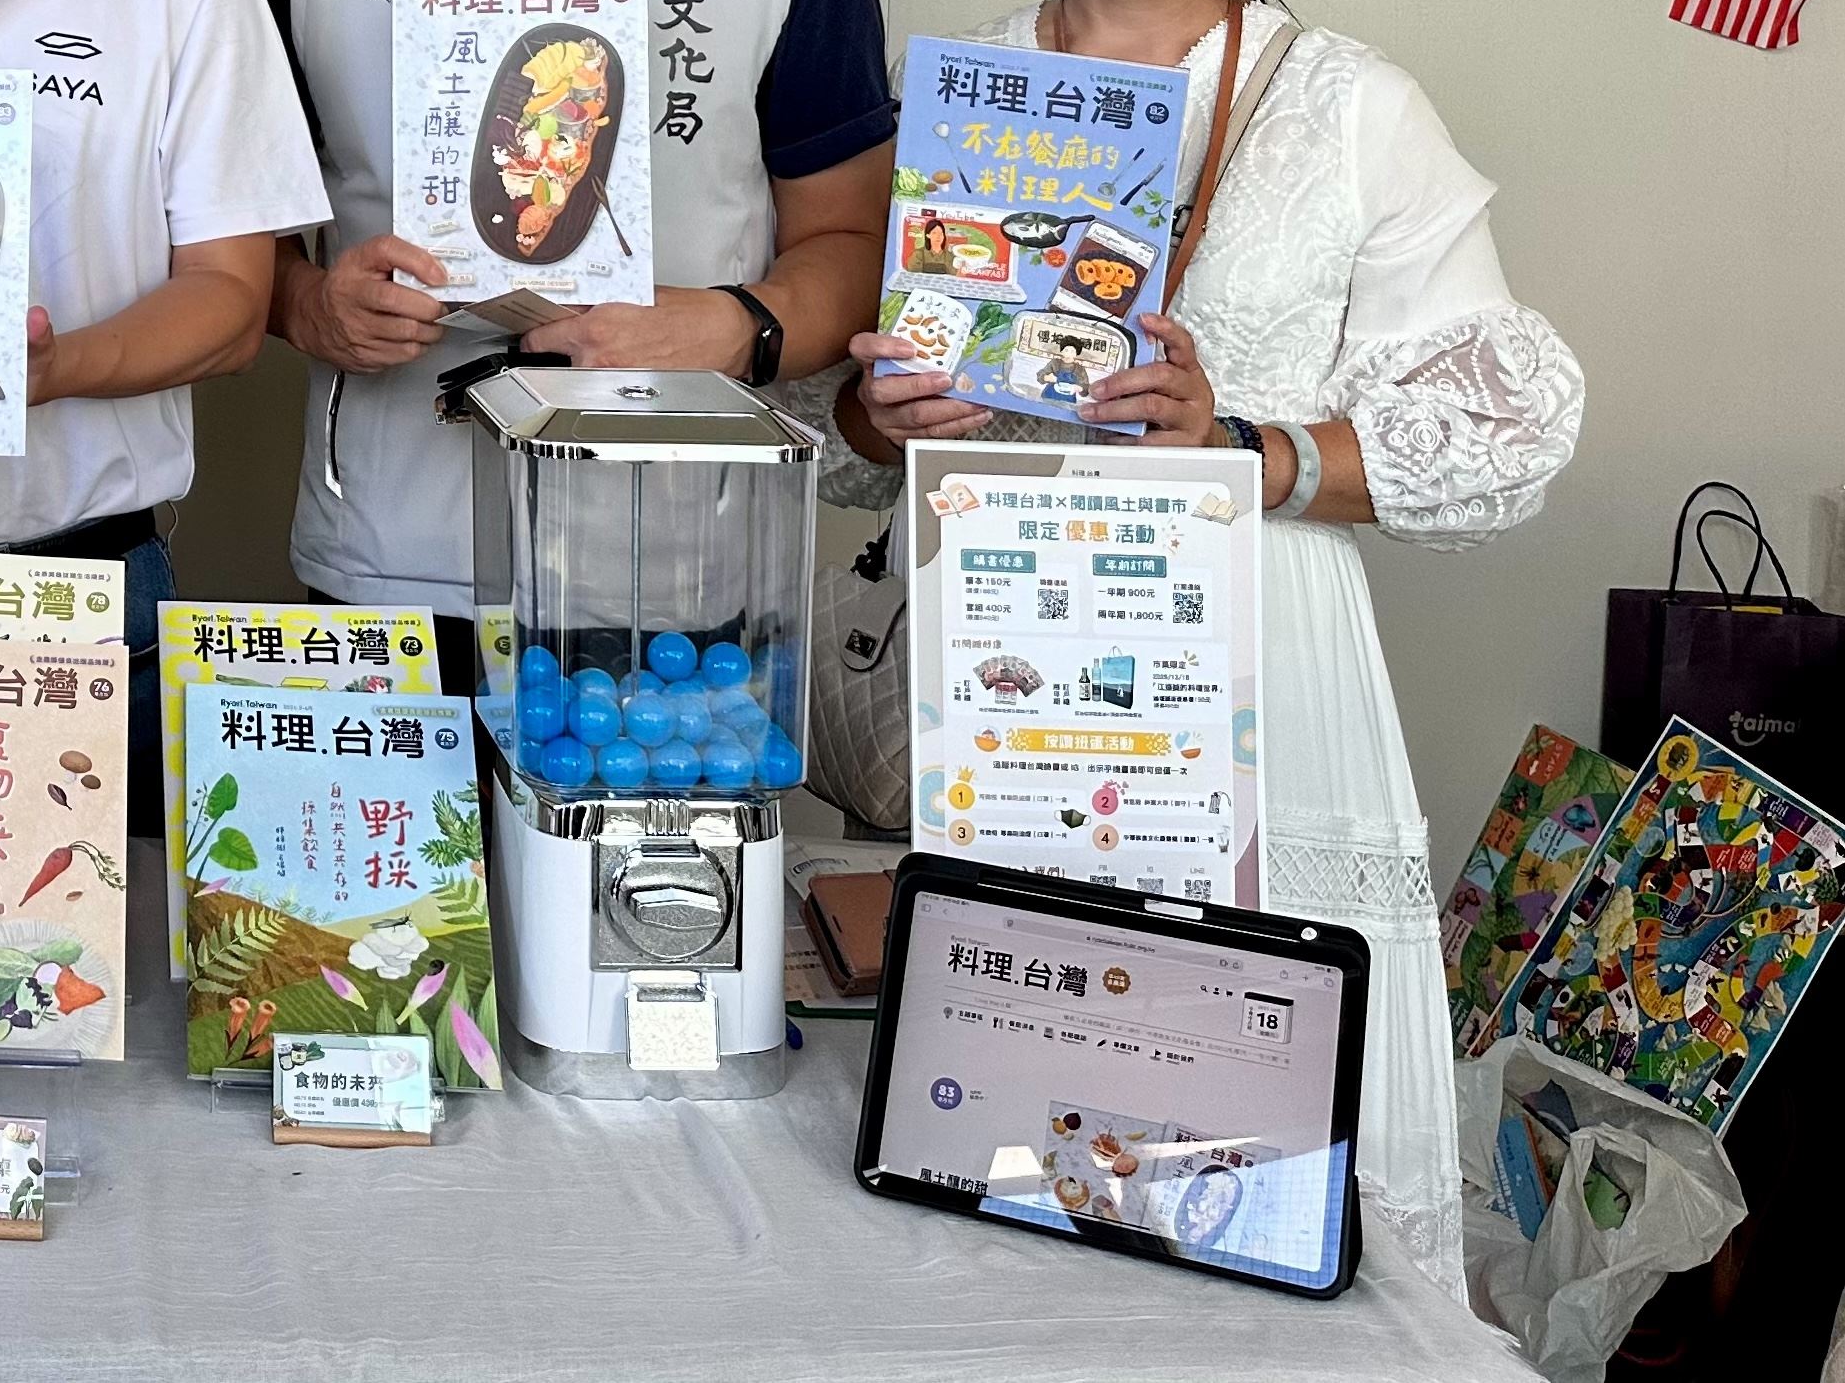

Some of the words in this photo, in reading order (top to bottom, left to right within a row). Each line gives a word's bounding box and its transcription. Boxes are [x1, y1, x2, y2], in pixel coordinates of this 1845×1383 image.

[1149, 106, 1164, 117] 82
[422, 31, 487, 206] 風土釀的甜
[962, 122, 1120, 169] 不在餐廳的
[976, 165, 1113, 211] 料理人
[90, 595, 106, 605] 78
[193, 624, 390, 666] 料理.台灣
[404, 640, 418, 649] 73
[93, 681, 109, 692] 76
[221, 709, 425, 759] 料理.台灣
[439, 732, 454, 742] 75
[958, 792, 964, 802] 1
[1101, 796, 1109, 807] 2
[957, 827, 966, 839] 3
[1101, 833, 1110, 844] 4
[359, 799, 417, 889] 野採
[948, 943, 1088, 998] 料理.台灣
[1256, 1012, 1278, 1030] 18
[938, 1085, 955, 1098] 83
